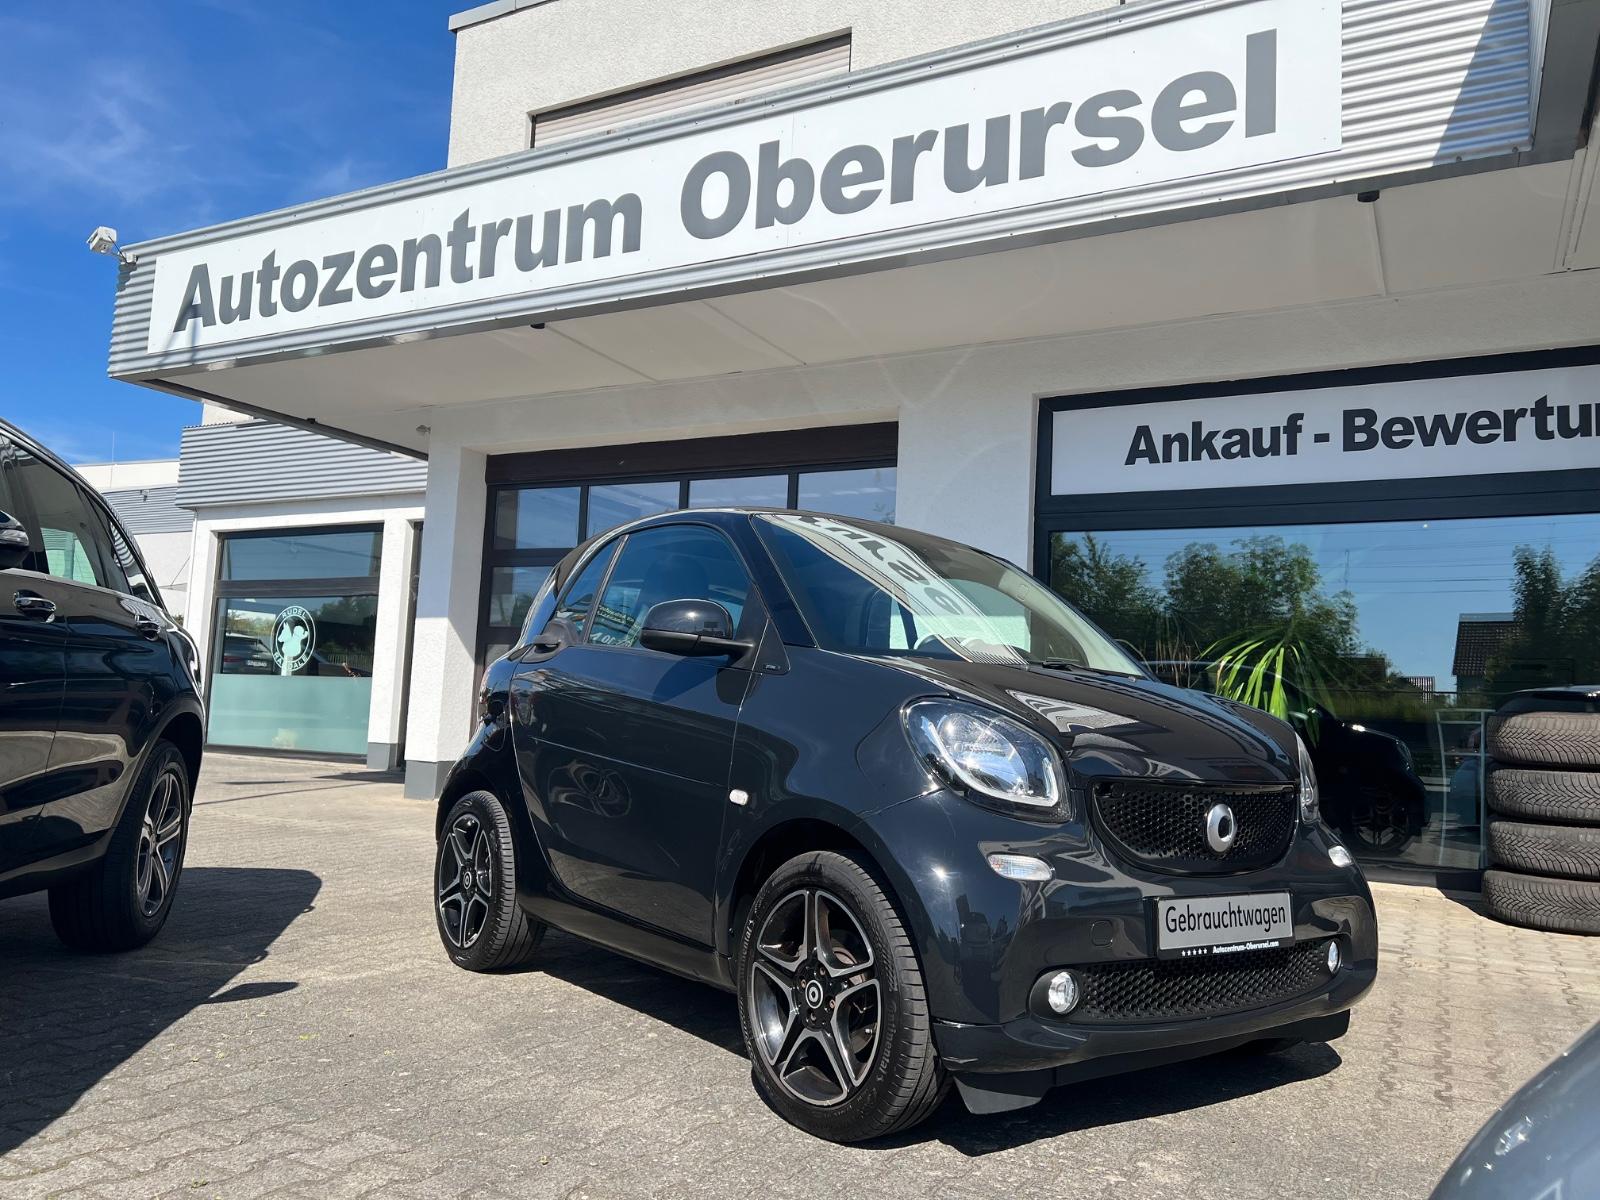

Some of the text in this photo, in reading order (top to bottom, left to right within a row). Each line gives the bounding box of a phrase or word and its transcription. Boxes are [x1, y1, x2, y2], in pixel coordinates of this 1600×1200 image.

[173, 28, 1278, 333] Autozentrum Oberursel
[1124, 412, 1305, 466] Ankauf
[1342, 394, 1600, 453] Bewertu
[281, 607, 307, 619] RUDEL
[1165, 901, 1286, 933] Gebrauchtwagen
